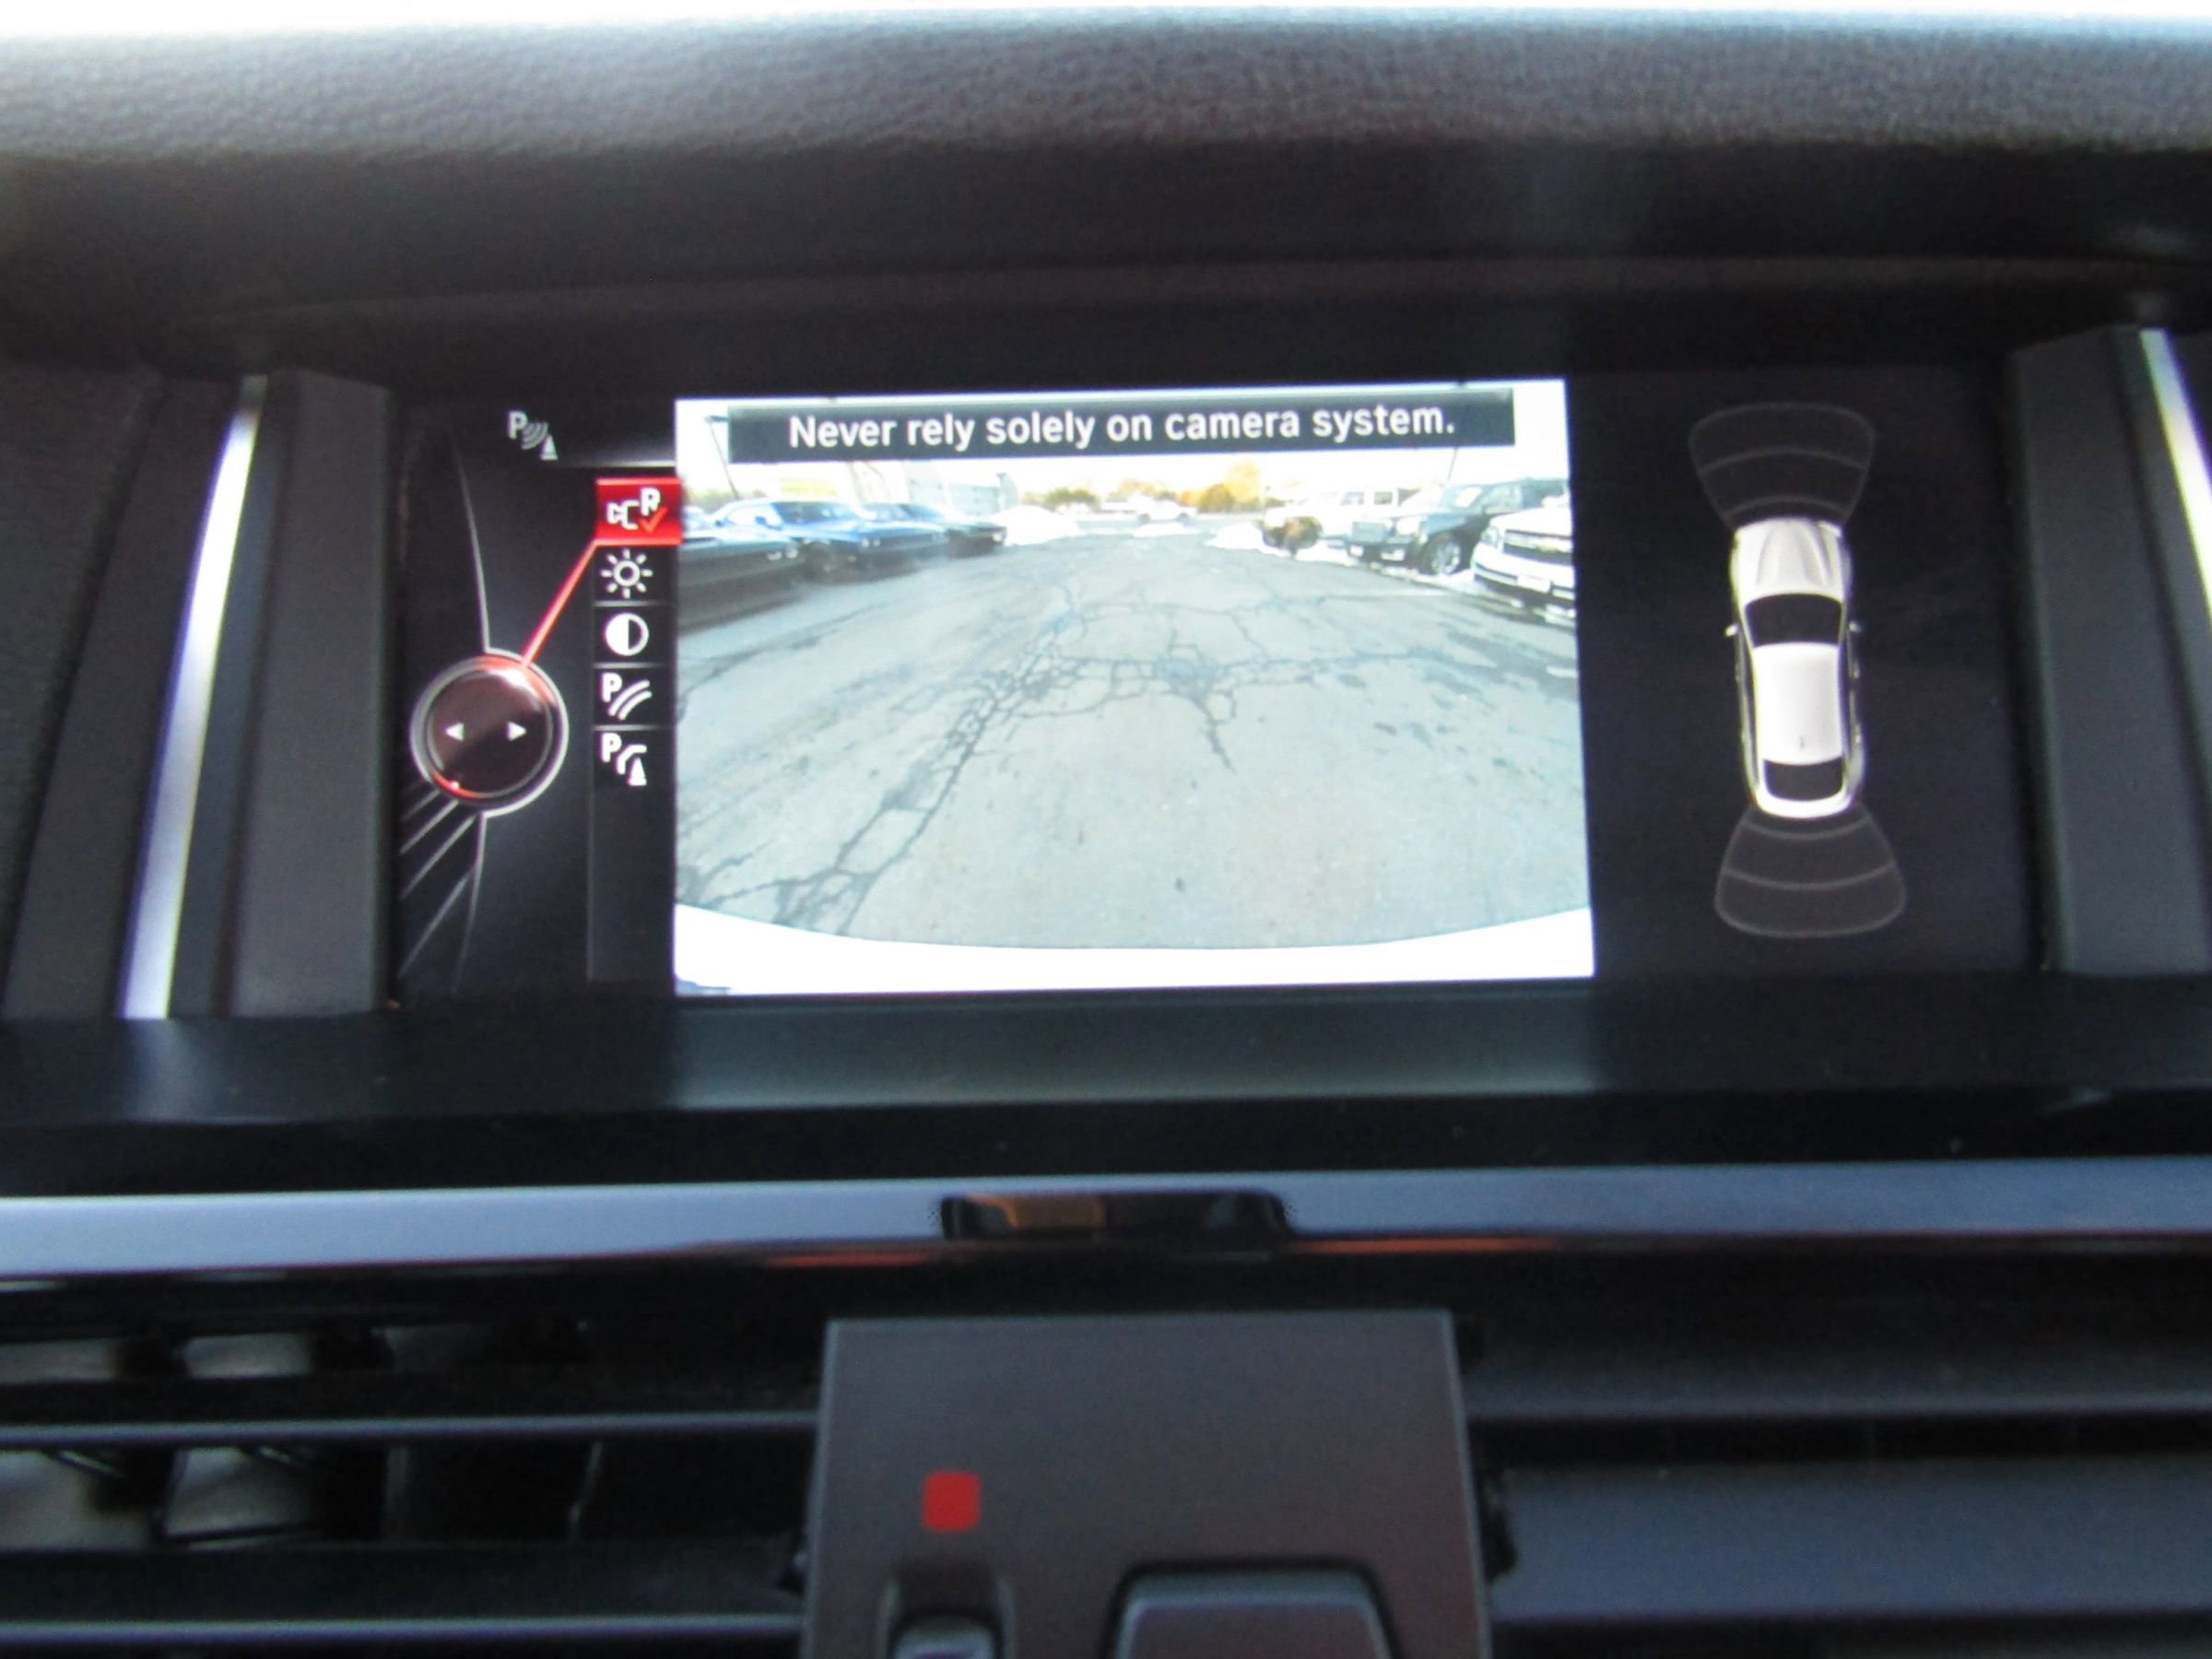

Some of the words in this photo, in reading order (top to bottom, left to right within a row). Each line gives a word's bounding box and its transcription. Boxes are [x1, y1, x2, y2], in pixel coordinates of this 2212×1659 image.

[508, 410, 528, 439] P
[789, 415, 897, 448] Never
[907, 412, 975, 452] rely
[985, 410, 1095, 449] solely
[1106, 413, 1153, 442] on
[1164, 410, 1300, 441] camera
[1312, 405, 1455, 443] system.
[602, 672, 622, 702] P
[602, 733, 622, 763] P
